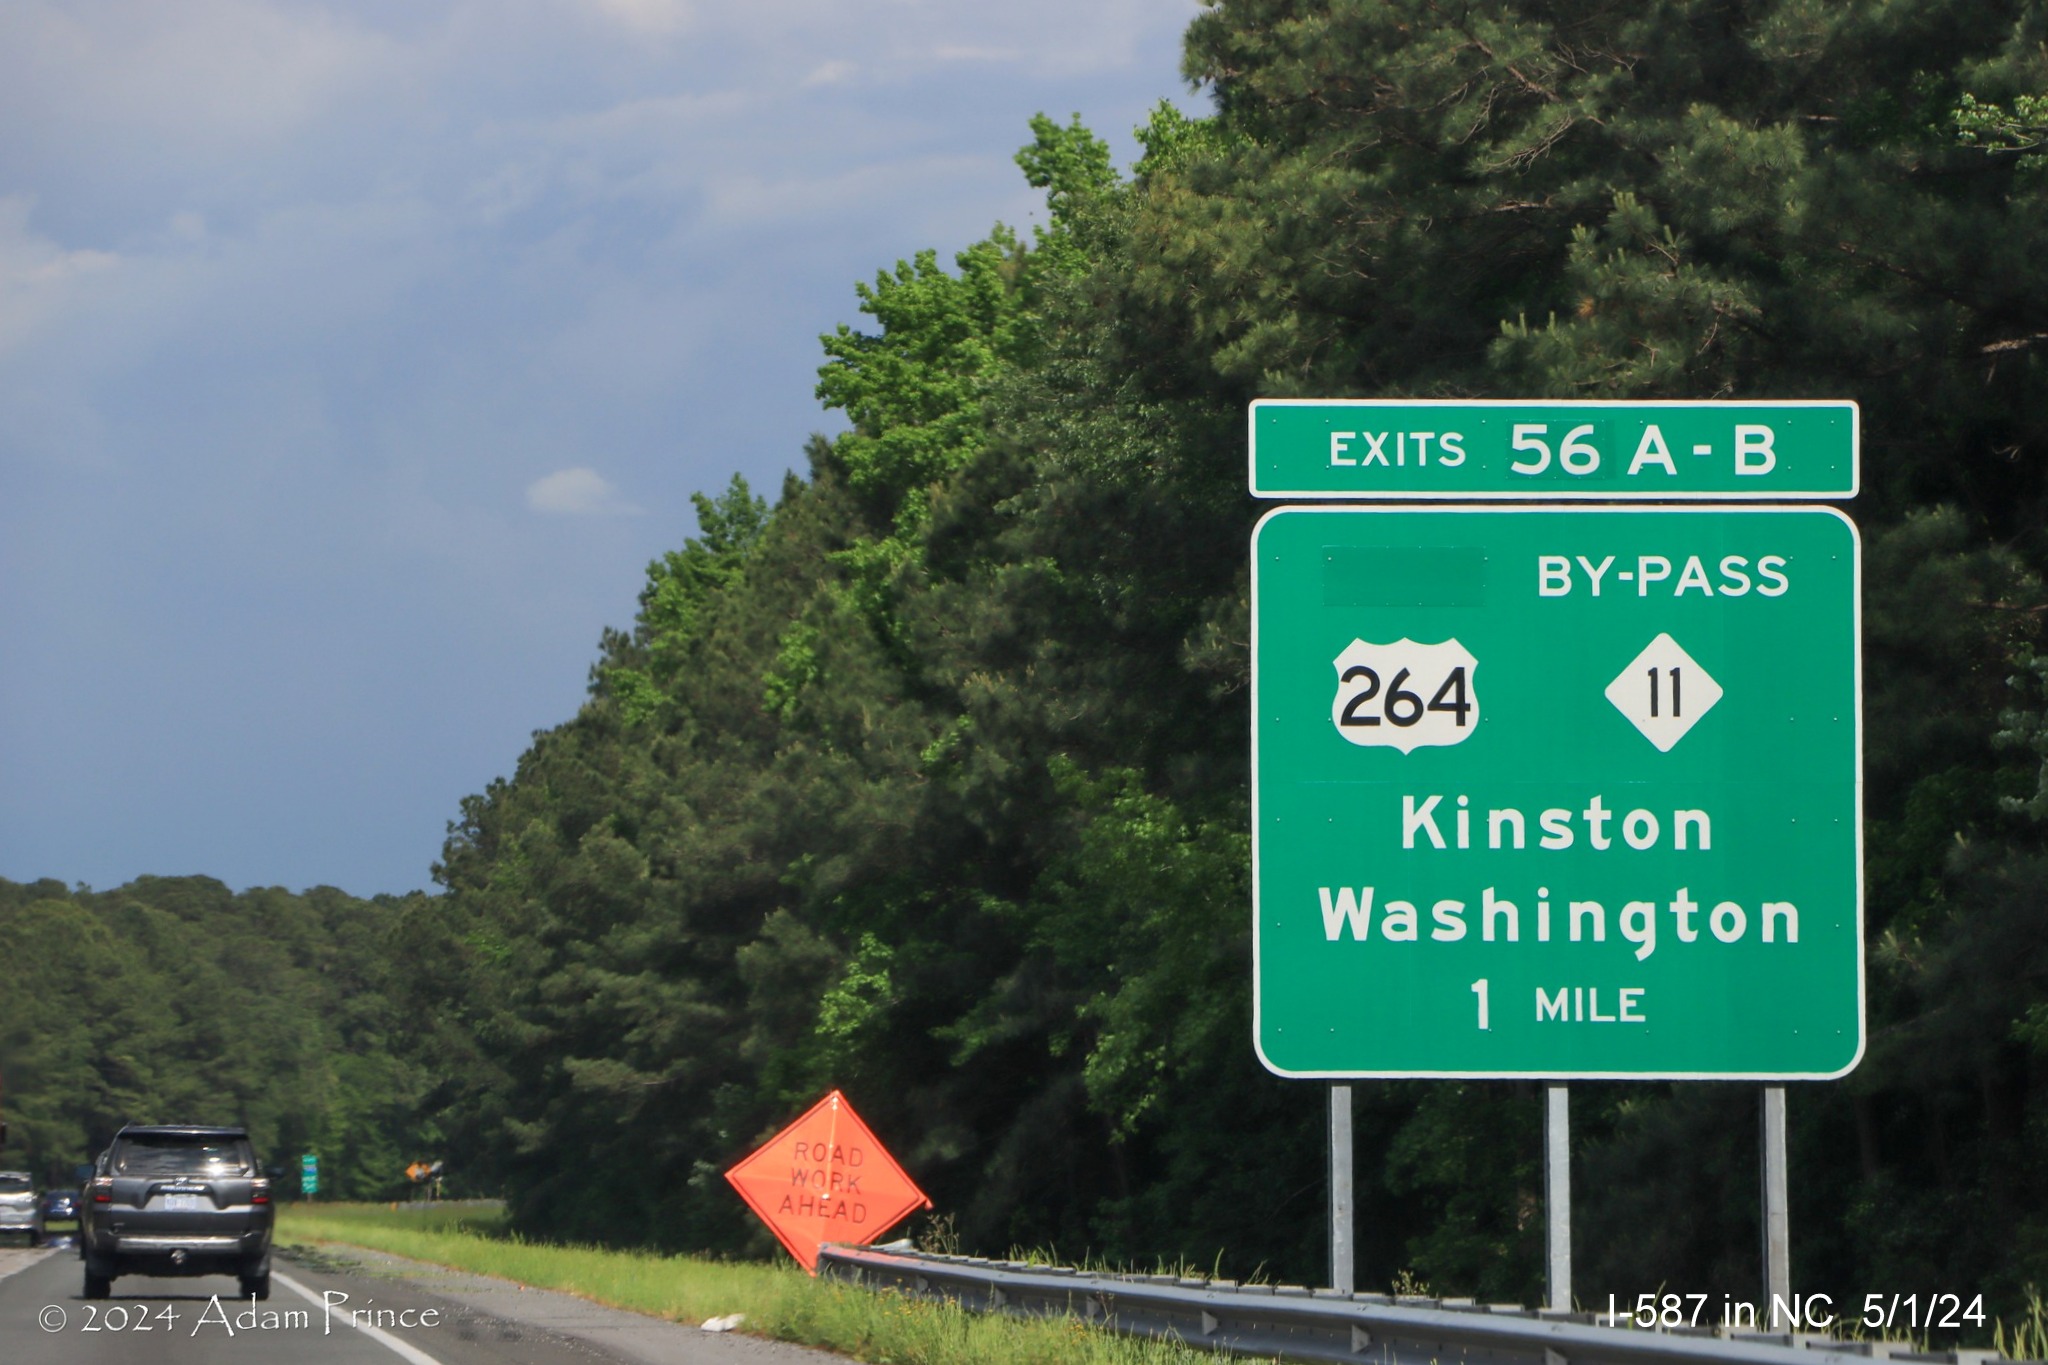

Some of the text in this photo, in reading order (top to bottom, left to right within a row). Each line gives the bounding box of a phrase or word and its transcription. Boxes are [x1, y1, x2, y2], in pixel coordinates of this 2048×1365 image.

[1330, 431, 1466, 467] EXITS
[1510, 423, 1601, 475] 56
[1538, 555, 1790, 597] BY-PASS
[1340, 665, 1471, 727] 264
[1647, 667, 1681, 718] 11
[1402, 794, 1711, 851] Kinston
[1318, 886, 1799, 962] Washington
[1471, 978, 1646, 1030] 1 MILE
[795, 1142, 863, 1167] ROAD
[791, 1168, 862, 1194] WORK
[779, 1194, 867, 1224] AHEAD
